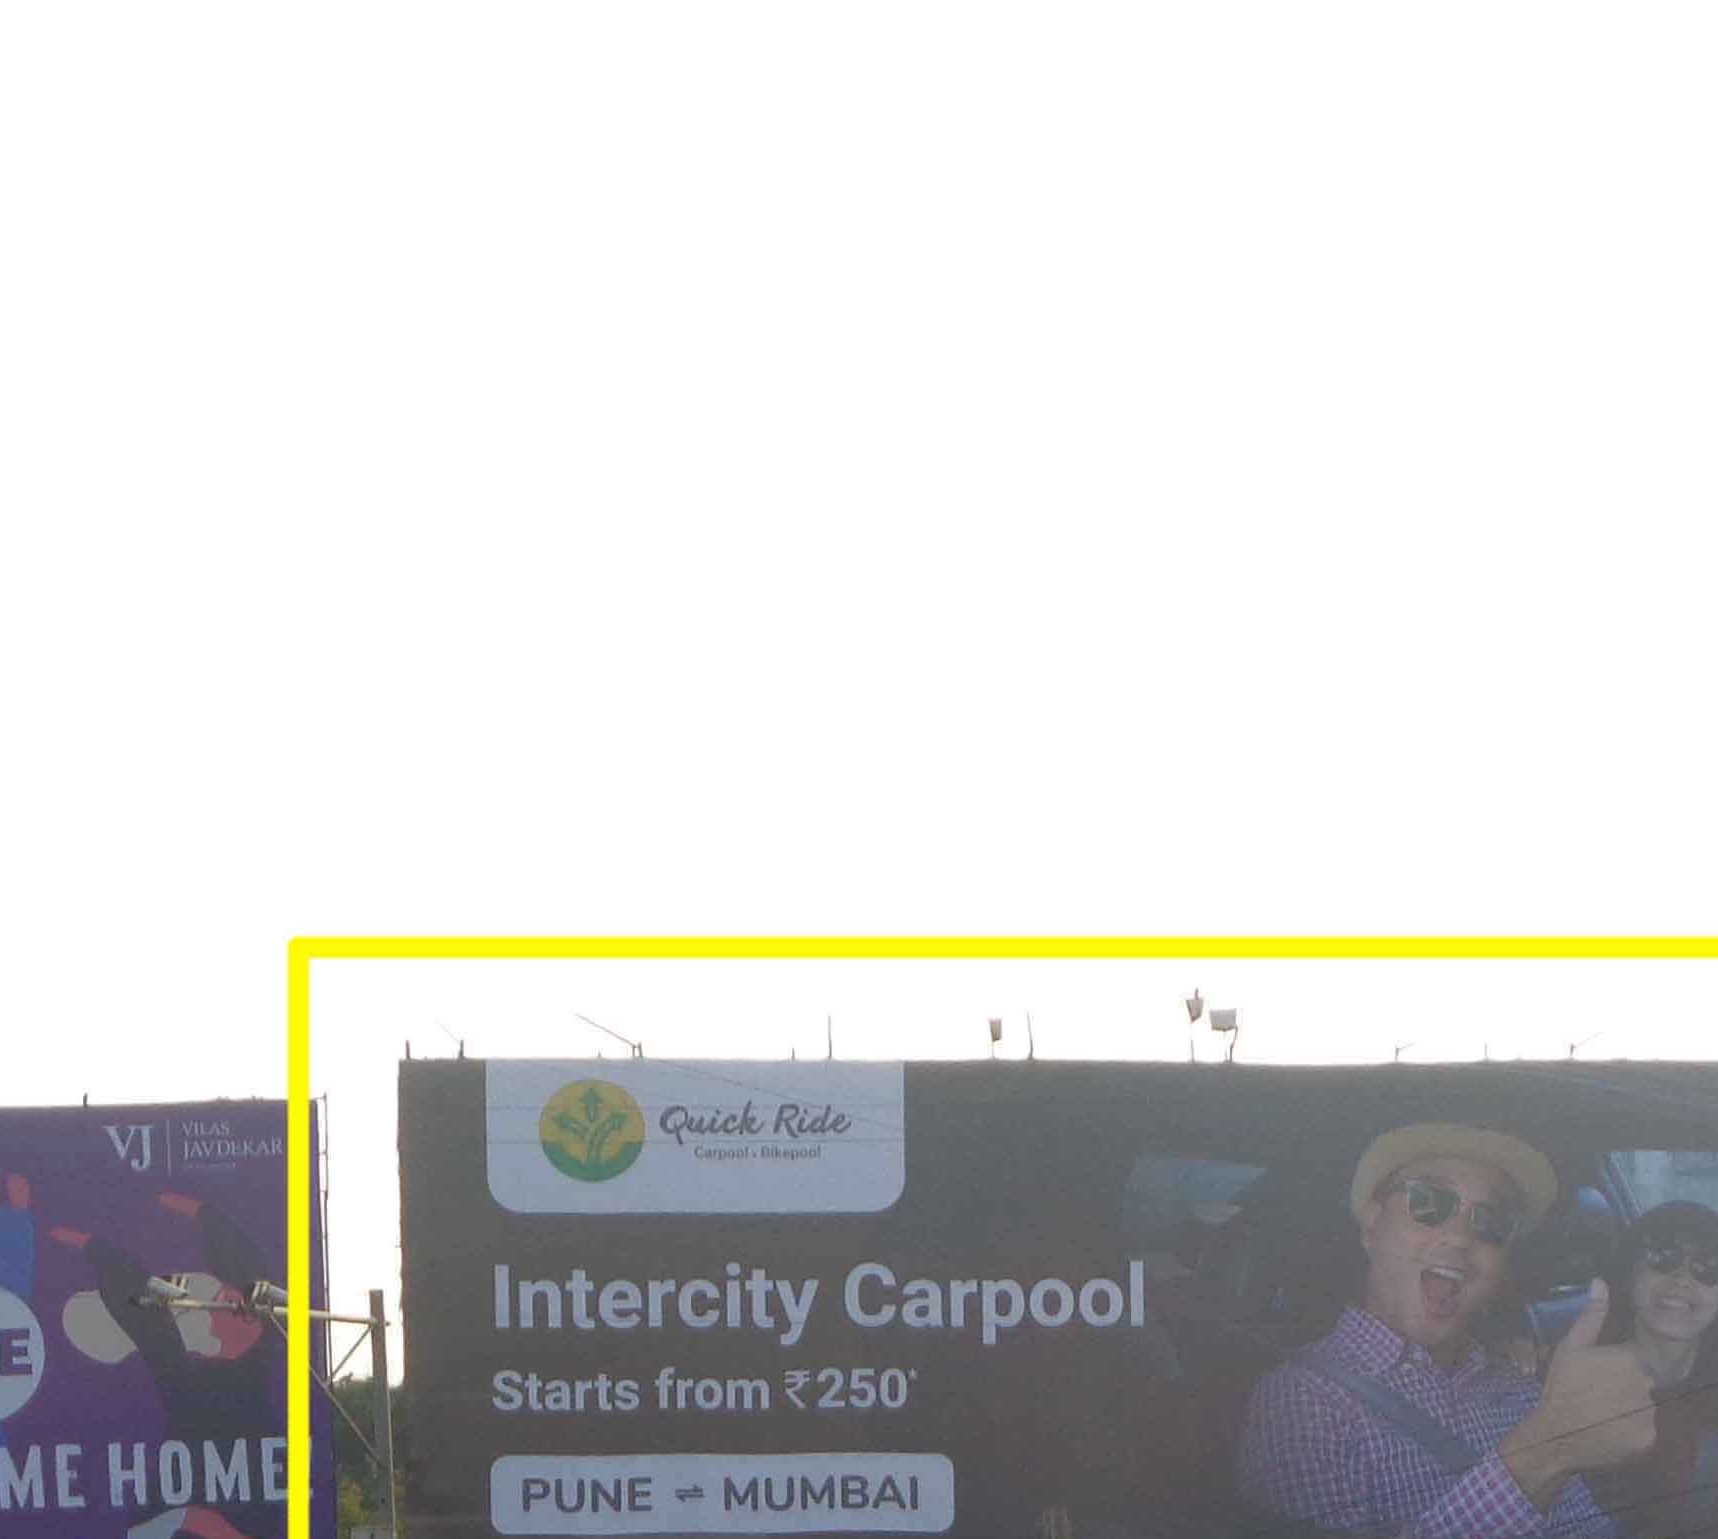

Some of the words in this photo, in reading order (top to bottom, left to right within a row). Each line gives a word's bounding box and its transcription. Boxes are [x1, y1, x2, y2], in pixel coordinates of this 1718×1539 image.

[183, 1120, 230, 1137] VILAS
[659, 1099, 765, 1145] Quick
[772, 1103, 852, 1139] Ride
[102, 1123, 154, 1173] VJ
[183, 1137, 284, 1160] JAVDEKAR
[693, 1145, 749, 1160] Carpool
[493, 1261, 820, 1346] Intercity
[843, 1259, 1147, 1346] Carpool
[491, 1370, 641, 1412] Starts
[655, 1367, 772, 1411] from
[522, 1476, 653, 1513] PUNE
[723, 1474, 921, 1512] MUMBAI
